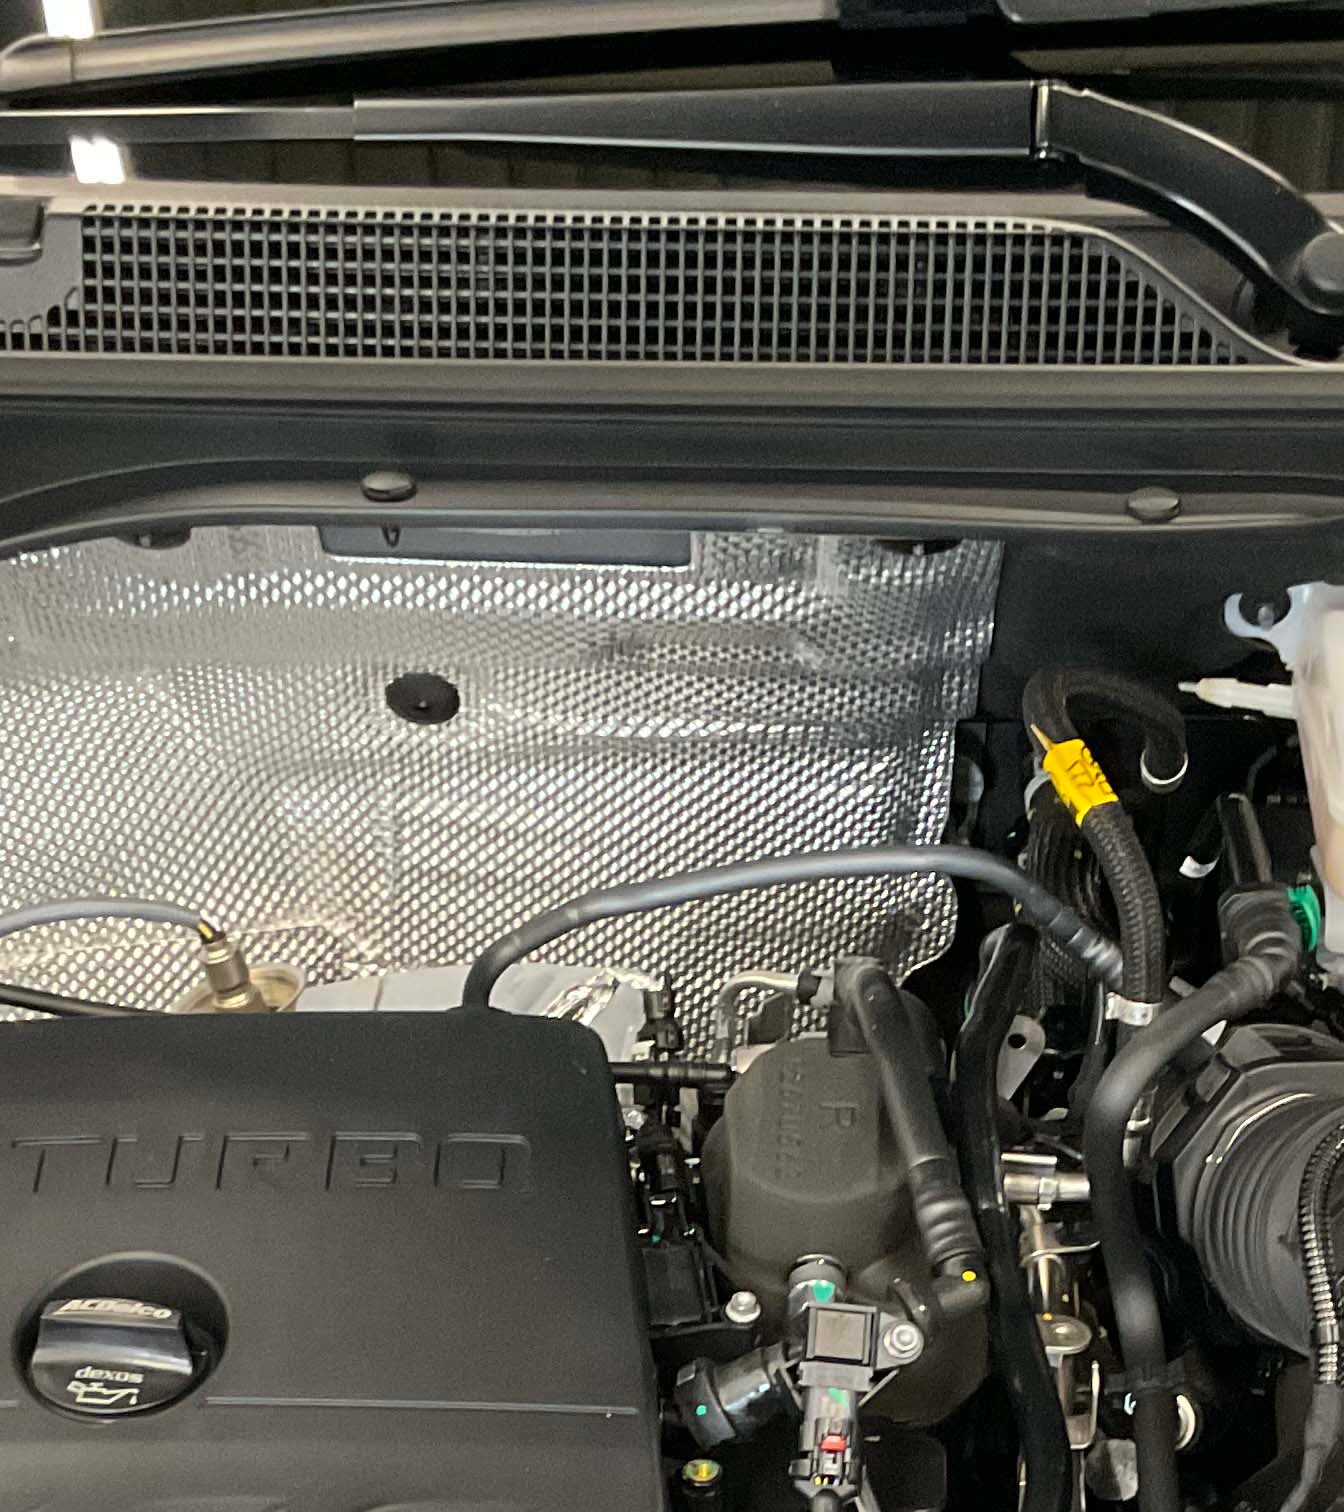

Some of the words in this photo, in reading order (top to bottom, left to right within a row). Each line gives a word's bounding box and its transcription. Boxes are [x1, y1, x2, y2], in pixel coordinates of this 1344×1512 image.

[11, 1131, 532, 1194] TURBO
[52, 1298, 173, 1320] ACDelco
[74, 1366, 145, 1384] dexos
